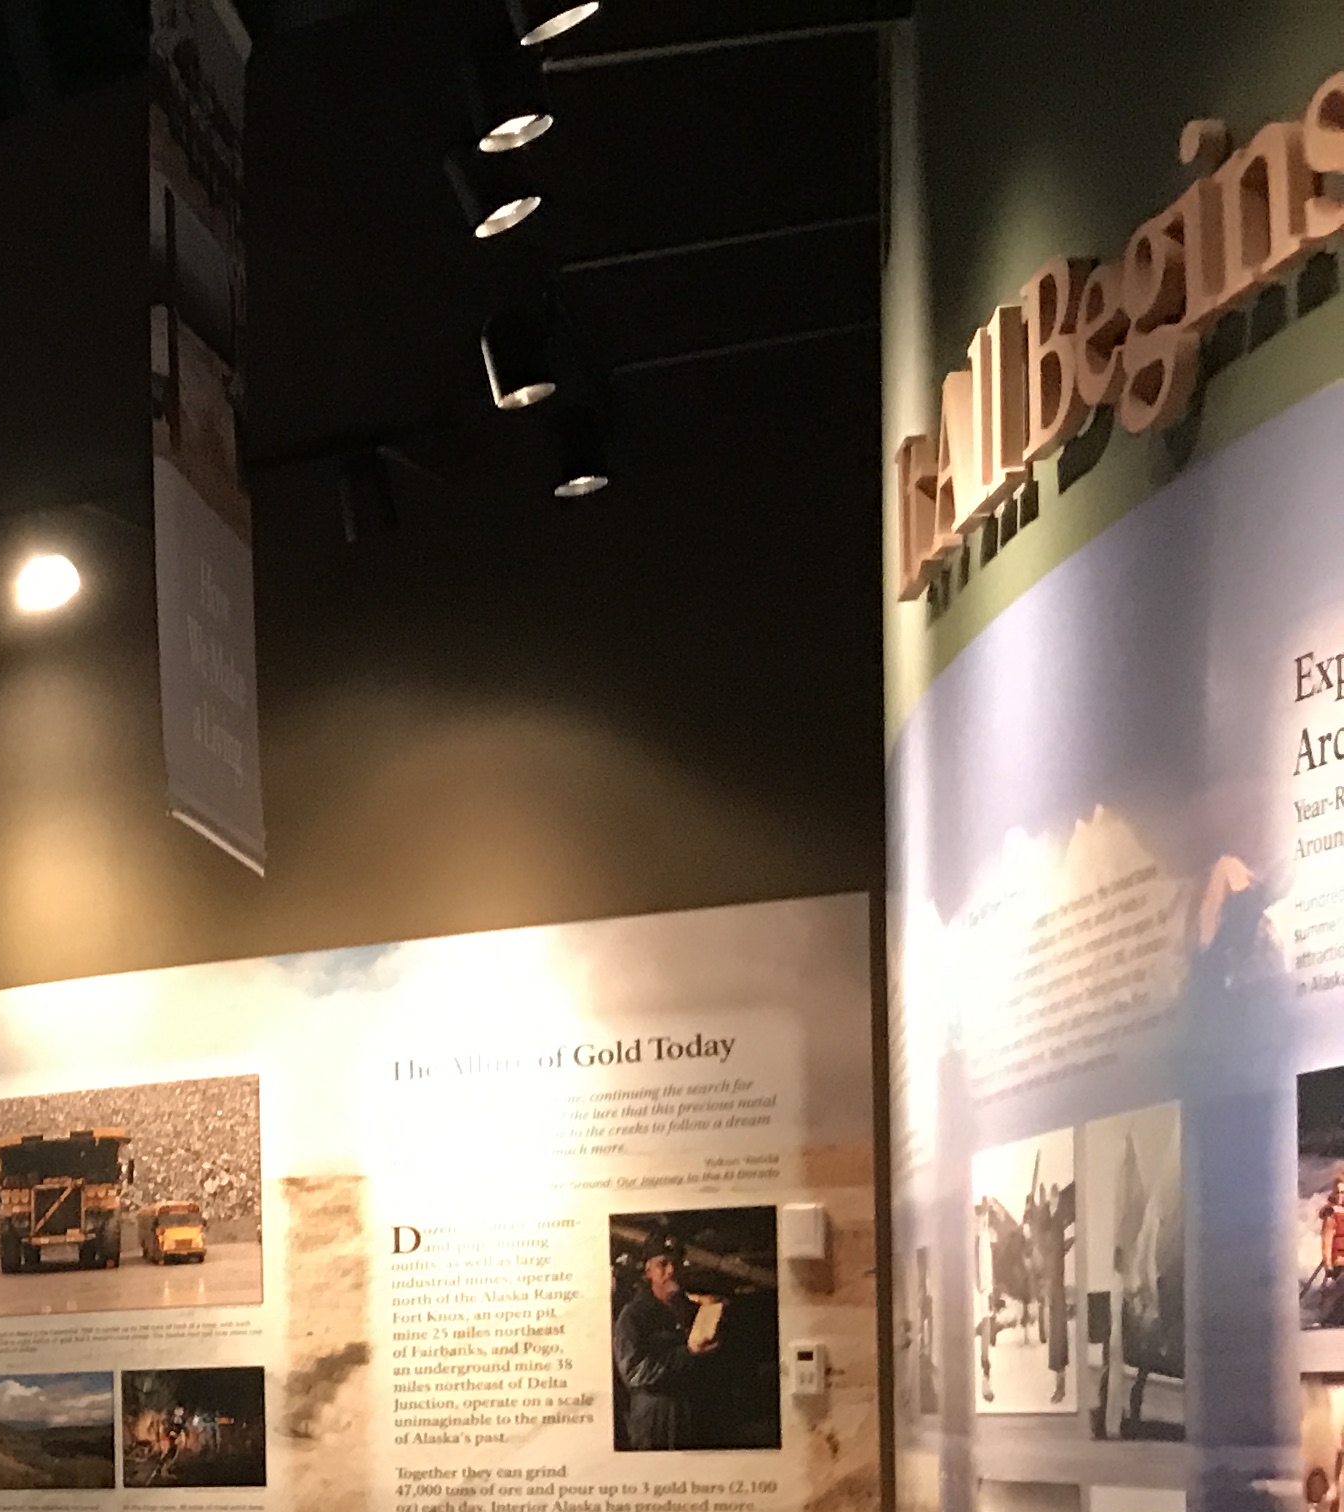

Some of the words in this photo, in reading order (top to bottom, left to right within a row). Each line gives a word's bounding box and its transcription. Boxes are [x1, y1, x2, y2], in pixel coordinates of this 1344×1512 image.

[933, 305, 1026, 551] All
[1020, 70, 1344, 464] Begins
[573, 1038, 642, 1067] Gold
[647, 1033, 736, 1063] Today
[589, 1085, 659, 1103] continuing
[663, 1083, 683, 1097] the
[687, 1079, 729, 1095] search
[732, 1078, 754, 1097] for
[621, 1104, 648, 1118] that
[651, 1103, 675, 1115] this
[677, 1099, 733, 1116] precious
[667, 1119, 711, 1137] follow
[713, 1120, 722, 1129] a
[725, 1115, 771, 1128] dream
[516, 1254, 552, 1267] large
[392, 1275, 461, 1289] industrial
[517, 1271, 573, 1285] operate
[392, 1294, 432, 1307] north
[436, 1293, 450, 1304] of
[454, 1292, 477, 1304] the
[483, 1290, 529, 1303] Alaska
[534, 1288, 584, 1302] Range.
[392, 1311, 422, 1324] Fort
[426, 1311, 469, 1322] Knox,
[473, 1312, 491, 1321] an
[495, 1309, 532, 1322] open
[535, 1307, 557, 1320] pit
[392, 1330, 428, 1341] mine
[432, 1327, 448, 1340] 25
[452, 1326, 491, 1339] miles
[494, 1324, 565, 1337] northeast
[392, 1346, 407, 1358] of
[411, 1343, 487, 1358] Fairbanks,
[491, 1342, 519, 1354] and
[523, 1341, 564, 1357] Pogo,
[392, 1366, 411, 1376] an
[414, 1360, 511, 1376] underground
[514, 1359, 552, 1372] mine
[556, 1358, 573, 1370] 38
[393, 1380, 431, 1393] miles
[435, 1378, 504, 1391] northeast
[508, 1377, 523, 1390] of
[527, 1376, 568, 1389] Delta
[393, 1397, 459, 1413] Junction,
[462, 1397, 519, 1411] operate
[522, 1398, 541, 1407] on
[544, 1397, 553, 1406] a
[557, 1392, 595, 1407] scale
[394, 1413, 492, 1430] unimaginable
[496, 1415, 511, 1425] to
[515, 1412, 538, 1424] the
[542, 1412, 594, 1424] miners
[394, 1433, 410, 1445] of
[413, 1431, 471, 1445] Alaska's
[474, 1432, 509, 1447] past.
[395, 1466, 458, 1482] Together
[462, 1466, 492, 1482] they
[496, 1467, 522, 1479] can
[525, 1465, 566, 1482] grind
[395, 1484, 442, 1498] 47,000
[445, 1485, 476, 1496] tons
[480, 1483, 495, 1496] of
[498, 1485, 523, 1496] ore
[526, 1482, 555, 1496] and
[558, 1483, 595, 1499] pour
[599, 1484, 618, 1497] up
[622, 1482, 638, 1495] to
[642, 1482, 649, 1495] 3
[653, 1480, 687, 1497] gold
[691, 1480, 725, 1495] bars
[728, 1480, 778, 1495] (2,100
[491, 1501, 548, 1512] Interior
[552, 1500, 601, 1512] Alaska
[605, 1500, 632, 1512] has
[713, 1501, 755, 1512] more
